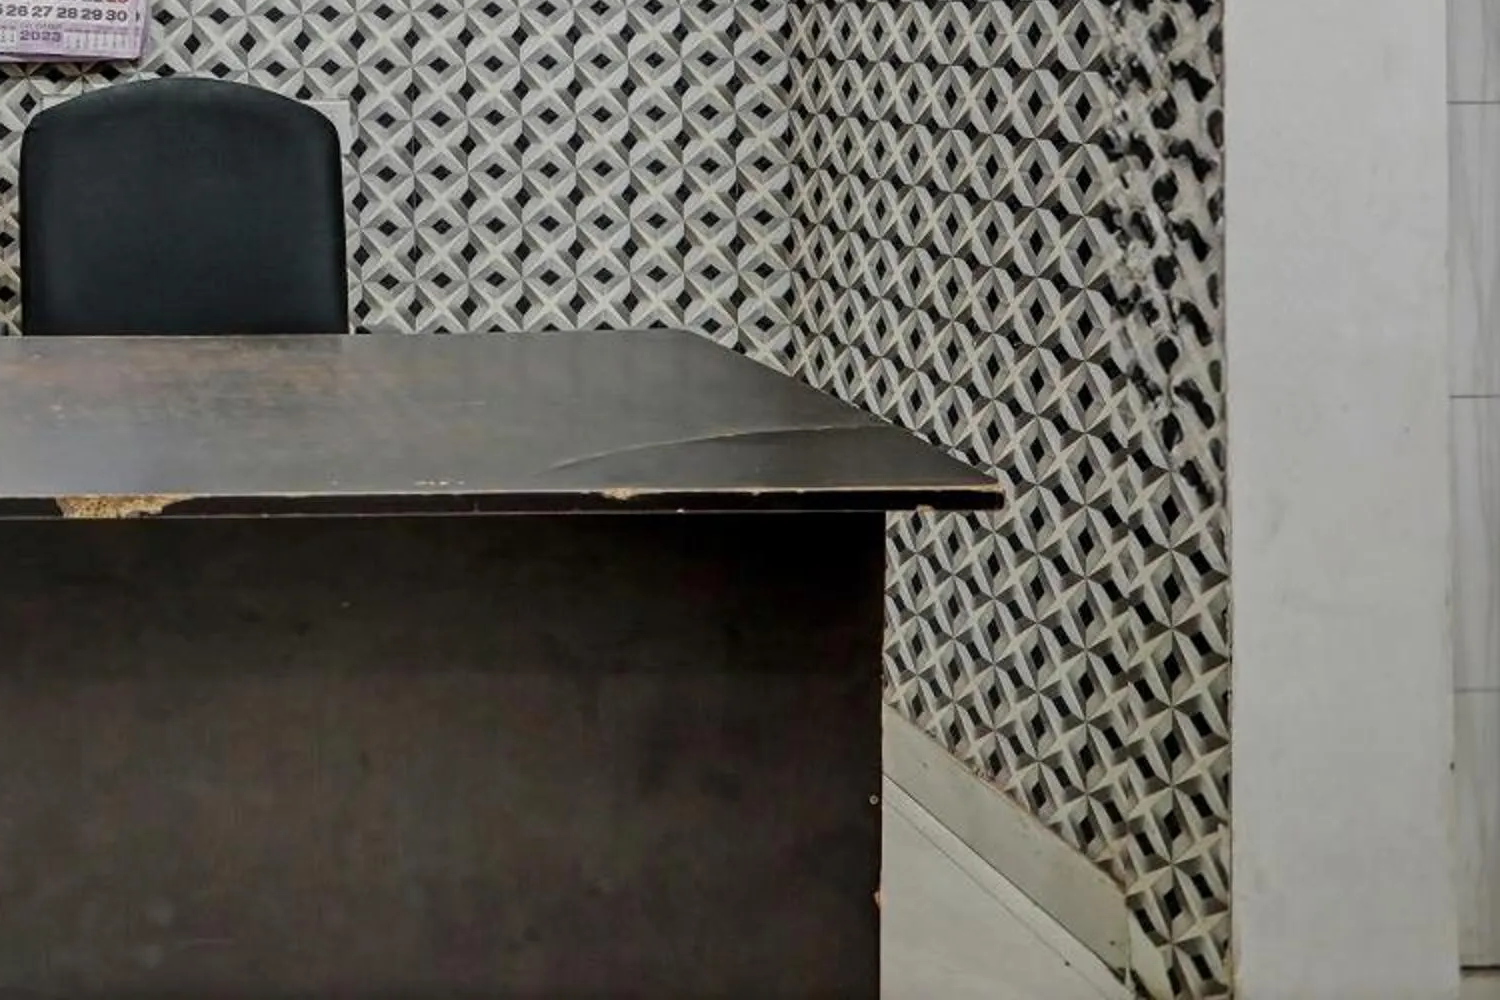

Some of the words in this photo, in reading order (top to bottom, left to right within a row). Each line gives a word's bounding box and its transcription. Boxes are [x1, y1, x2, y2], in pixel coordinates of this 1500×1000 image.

[6, 5, 28, 17] 26
[32, 6, 53, 18] 27
[57, 7, 78, 19] 28
[81, 8, 102, 20] 29
[105, 10, 127, 21] 30
